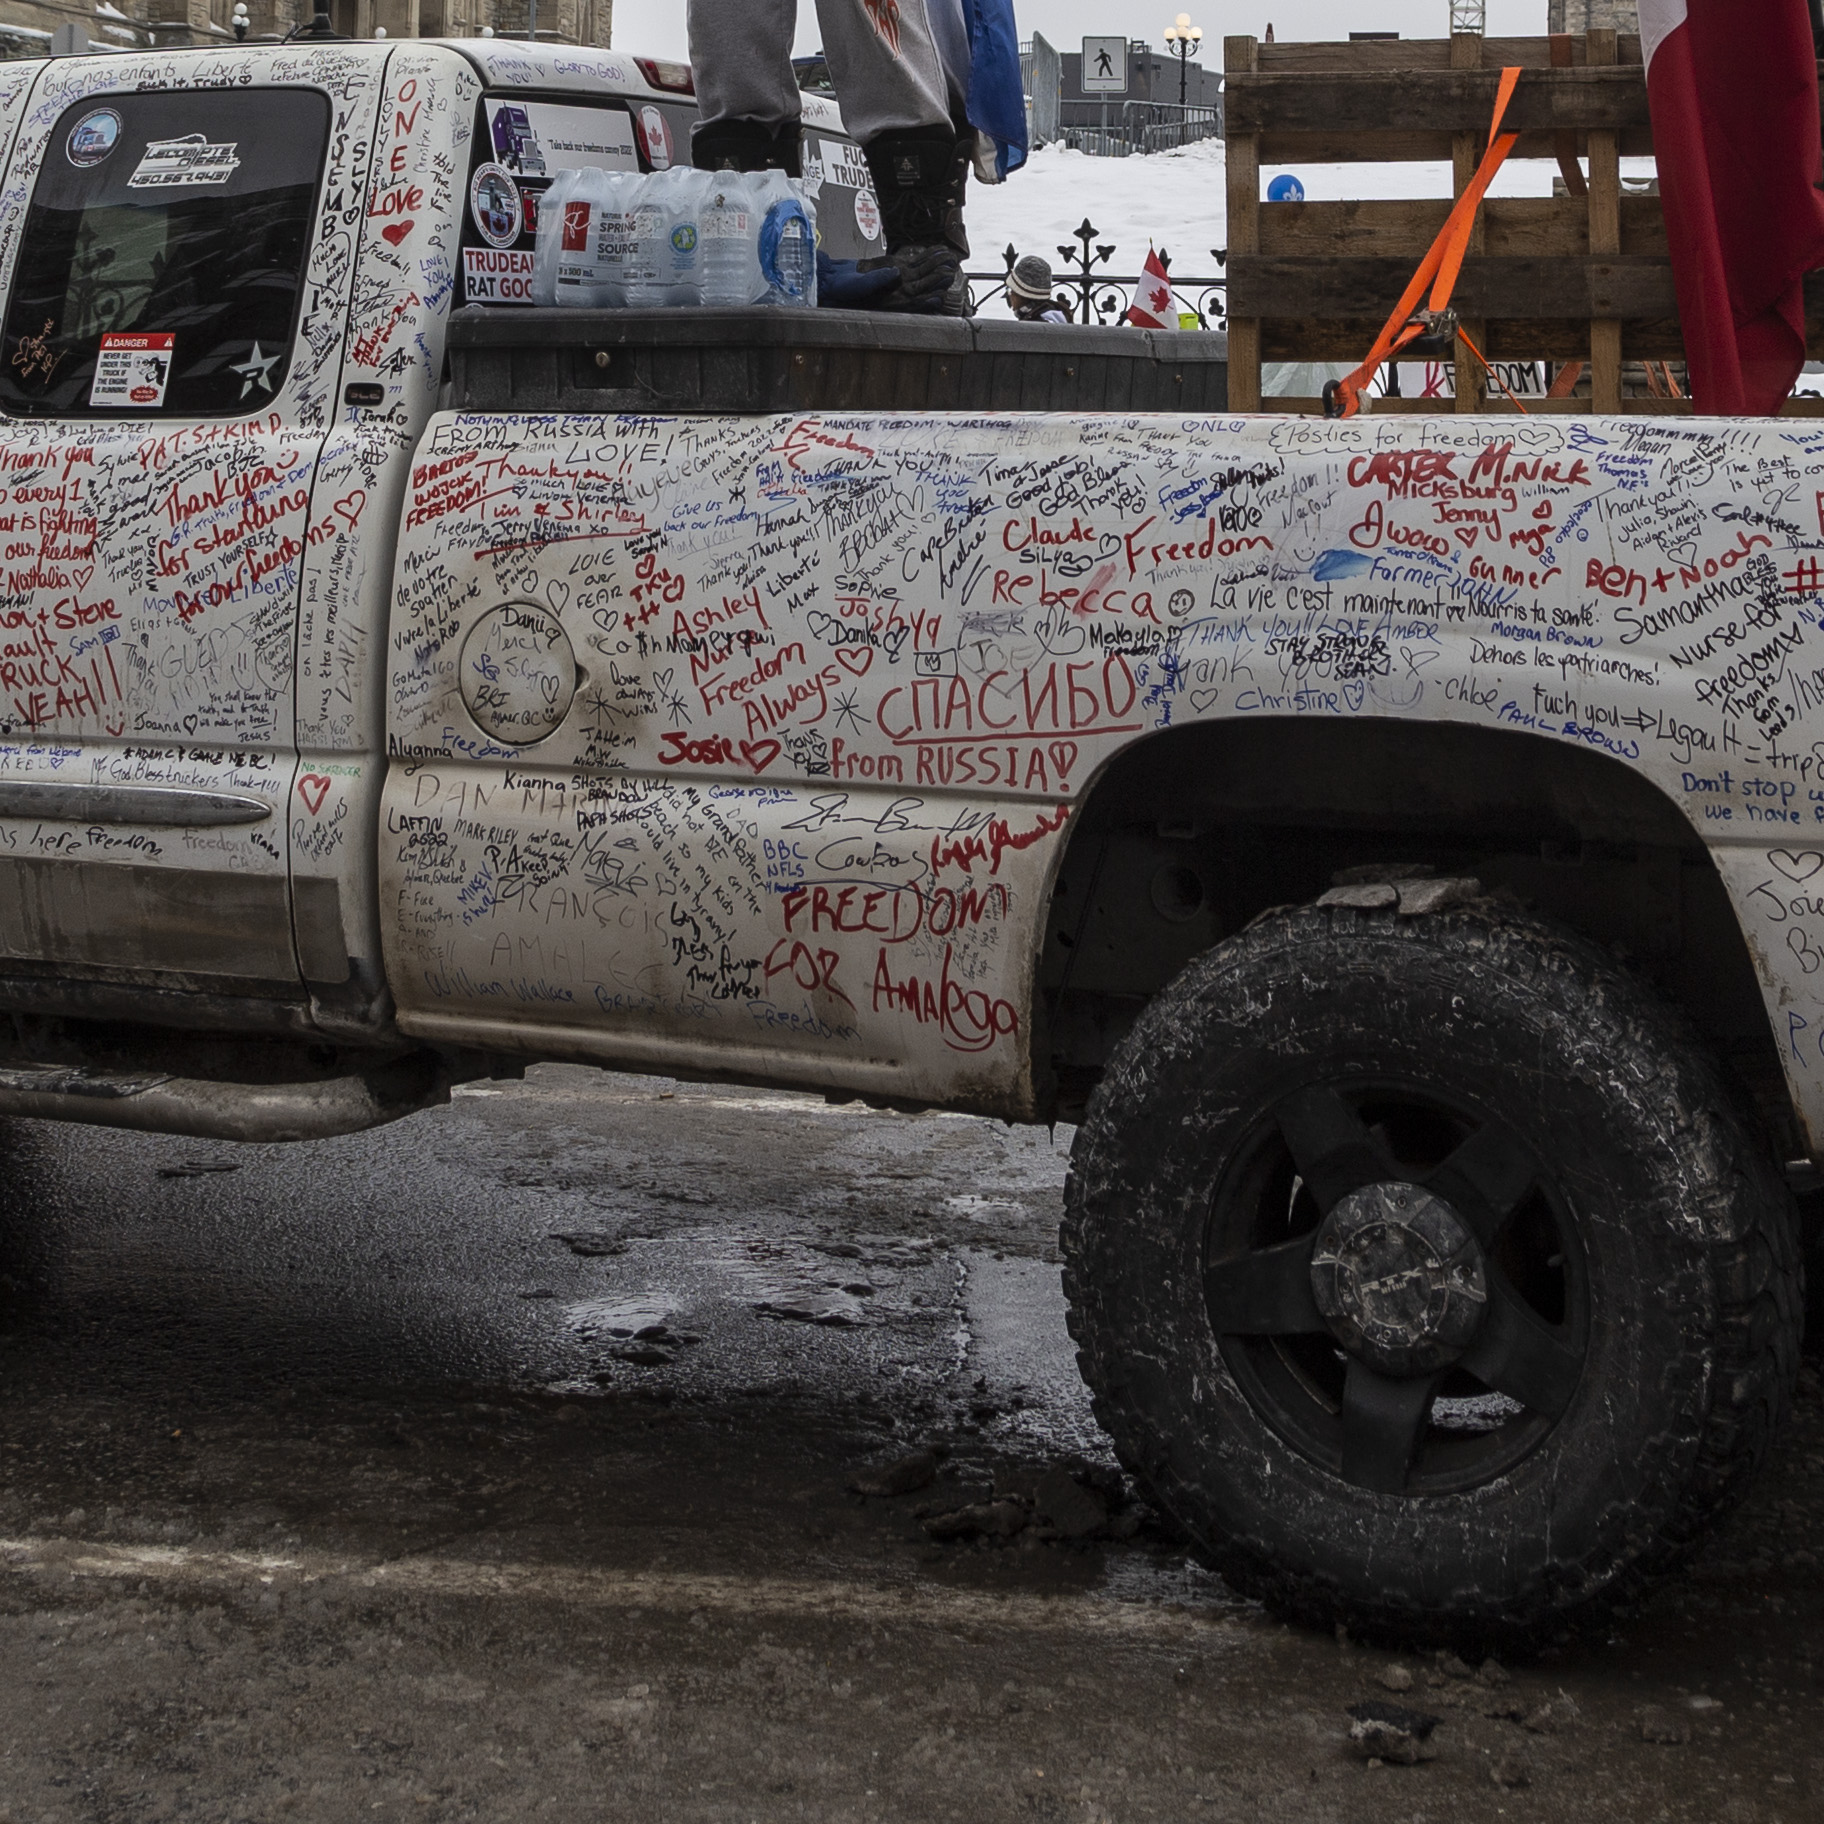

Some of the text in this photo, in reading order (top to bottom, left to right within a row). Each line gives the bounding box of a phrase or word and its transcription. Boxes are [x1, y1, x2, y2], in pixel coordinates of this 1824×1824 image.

[599, 221, 636, 233] SPRING
[597, 243, 639, 254] SOURCE
[113, 339, 148, 347] DANGER
[564, 435, 675, 466] LOVE!
[1286, 423, 1516, 447] Posties for freedom
[1622, 436, 1672, 456] Megan
[1594, 450, 1654, 466] Freedom
[1597, 464, 1647, 479] Thomas
[21, 512, 36, 533] is
[37, 506, 98, 545] fighting
[754, 507, 811, 538] Hannah
[1002, 518, 1098, 552] Claude
[5, 539, 34, 561] our
[184, 531, 266, 590] TRUST YOURSELF
[1124, 516, 1274, 582] Freedom
[1679, 531, 1773, 590] Noah
[766, 549, 821, 599] Liberté
[576, 586, 623, 609] FEAR
[991, 568, 1164, 625] Rebecca
[1210, 573, 1236, 609] La
[1248, 580, 1276, 610] vie
[1285, 582, 1335, 611] c'est
[53, 599, 123, 627] Steve
[673, 585, 769, 636] Ashley
[1613, 572, 1747, 645] Samantha
[1670, 604, 1787, 670] Nurse for
[1533, 651, 1556, 668] les
[698, 642, 807, 716] Freedom
[742, 663, 841, 739] Always
[876, 653, 1138, 739] СПАСИБО
[1234, 686, 1342, 714] Christine
[134, 714, 181, 733] Joanna
[830, 738, 903, 779] from
[503, 770, 566, 792] Kianna
[1680, 772, 1735, 794] Don't
[1742, 779, 1796, 810] stop
[1746, 802, 1801, 825] have
[29, 824, 81, 855] here
[763, 839, 808, 861] BBC
[781, 880, 1008, 943] FREEDOM
